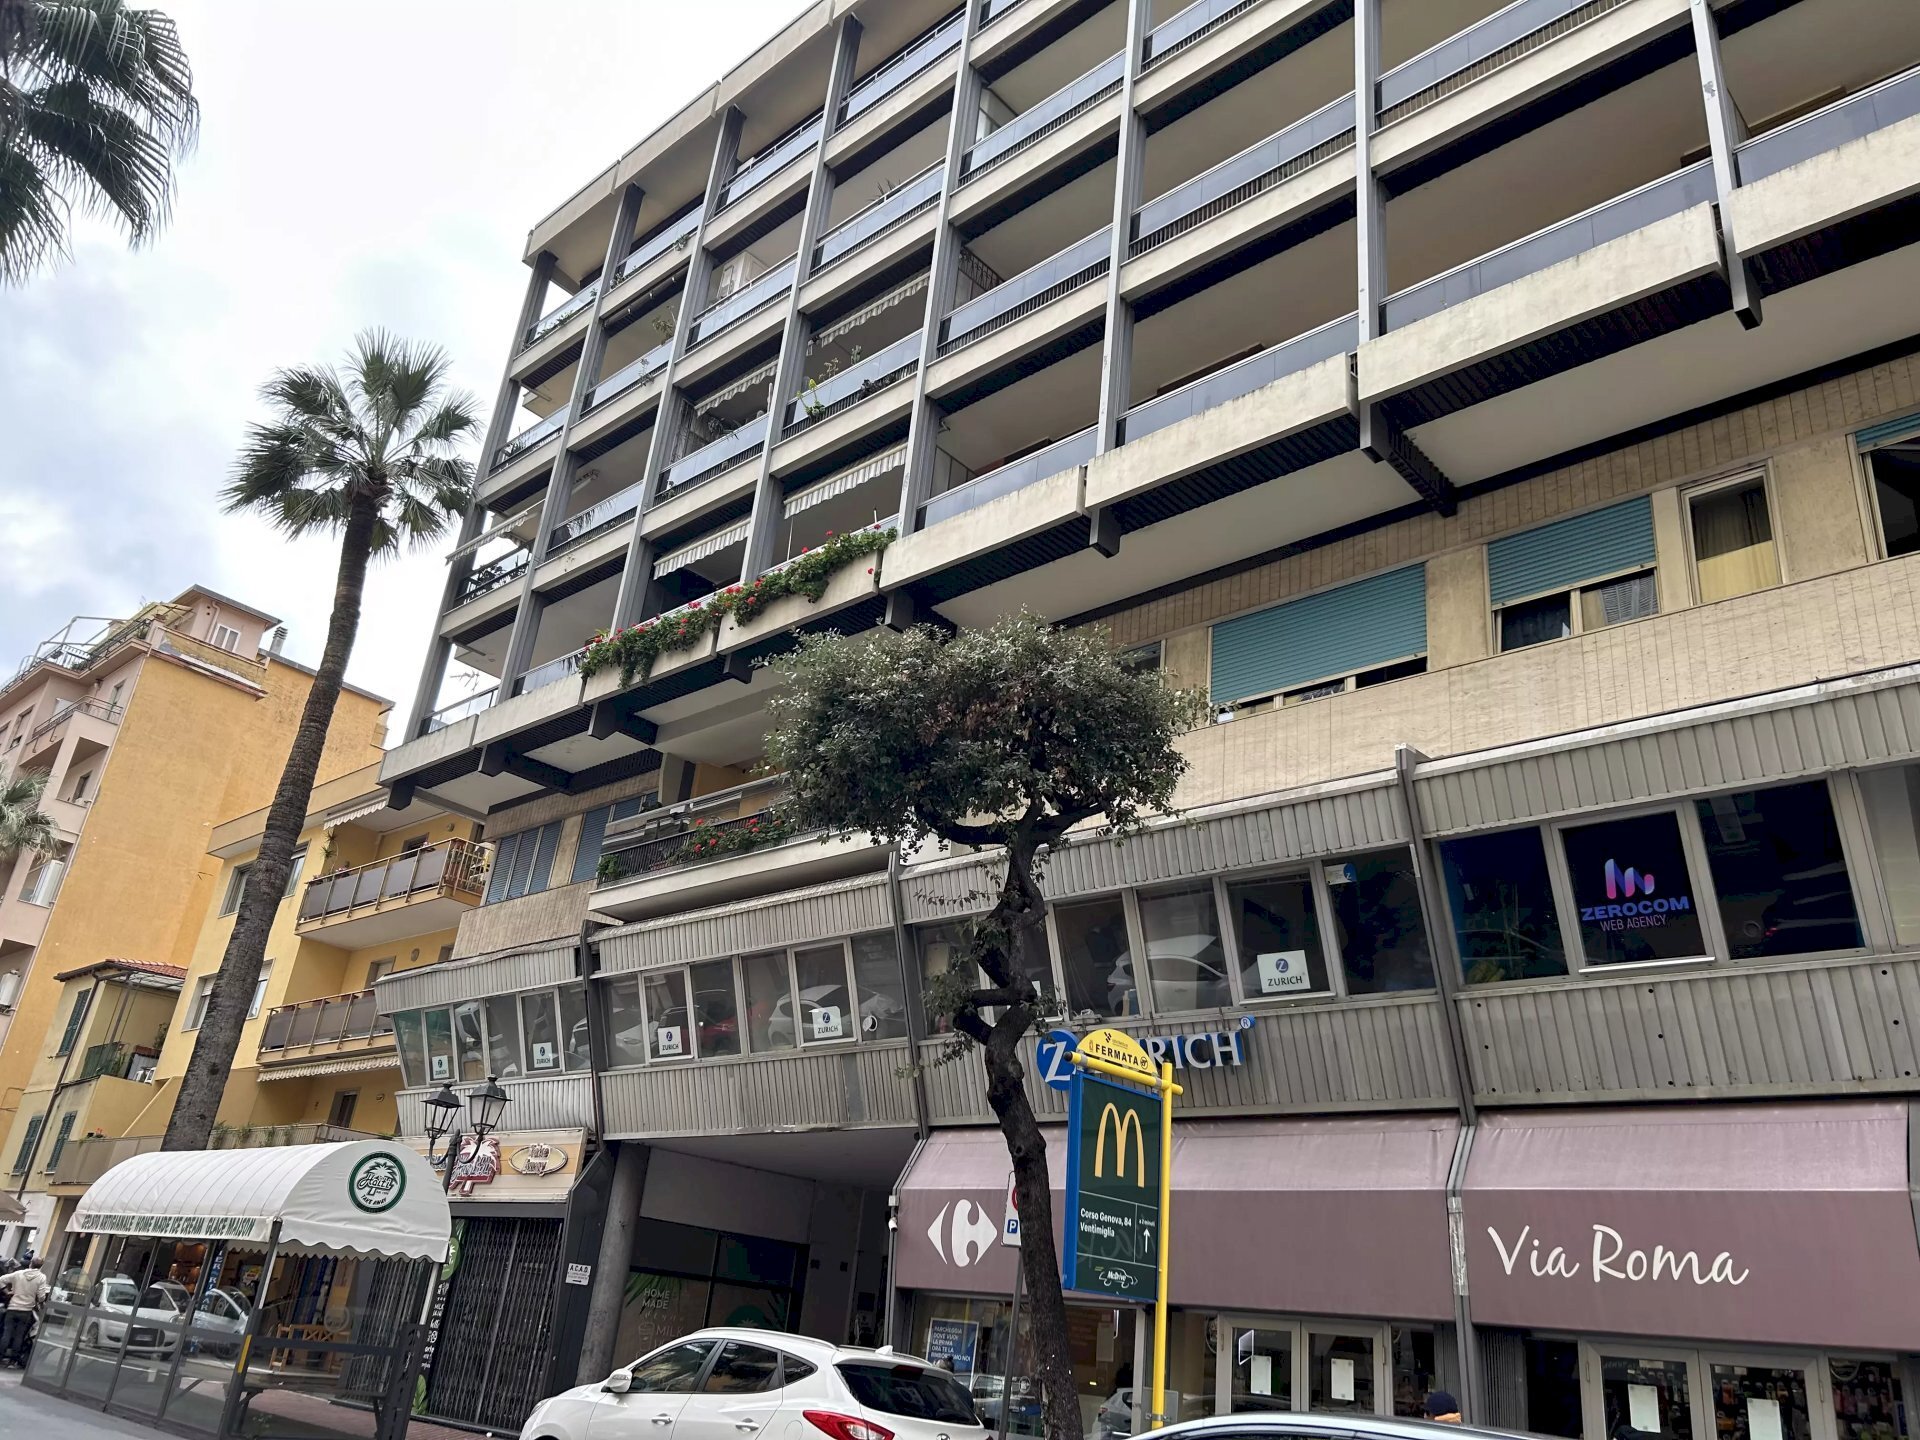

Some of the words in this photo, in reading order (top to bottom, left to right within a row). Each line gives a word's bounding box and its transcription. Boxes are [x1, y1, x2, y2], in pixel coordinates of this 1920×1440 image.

[1580, 896, 1690, 921] ZEROCOM
[1600, 919, 1624, 932] WEB
[1627, 914, 1667, 929] AGENCY
[1267, 975, 1303, 987] ZURICH
[817, 1025, 838, 1034] ZURICH
[662, 1043, 679, 1051] ZURICH
[1095, 1043, 1139, 1066] FERMATA
[536, 1057, 551, 1065] ZURICH
[1080, 1207, 1099, 1220] Corso
[1100, 1211, 1124, 1227] Genova,
[1124, 1216, 1132, 1227] 84
[134, 1215, 154, 1233] HOME
[152, 1216, 171, 1234] MADE
[170, 1216, 181, 1235] ICE
[180, 1216, 204, 1235] CREAM
[1080, 1221, 1115, 1238] Ventimiglia
[1487, 1225, 1580, 1278] Via
[1592, 1224, 1750, 1286] Roma
[1107, 1270, 1127, 1281] McDrive
[643, 1288, 671, 1300] HOME
[642, 1299, 669, 1310] MADE
[656, 1325, 683, 1338] MILK
[934, 1326, 963, 1334] PARCHEGGIA
